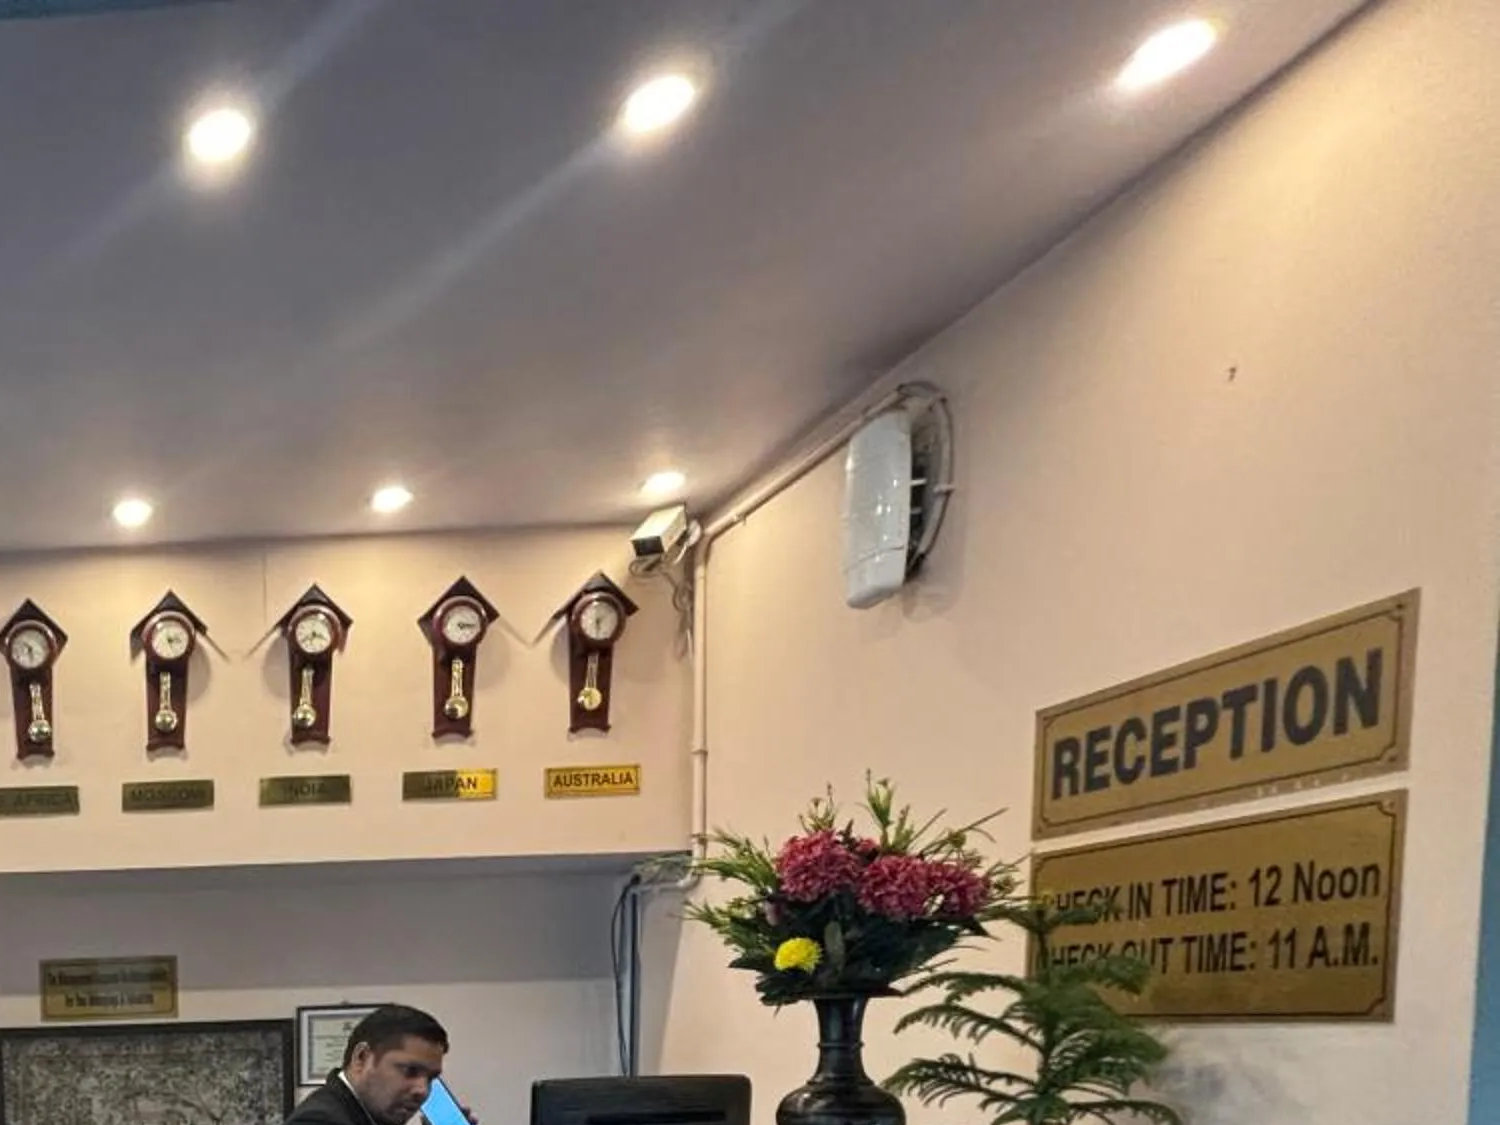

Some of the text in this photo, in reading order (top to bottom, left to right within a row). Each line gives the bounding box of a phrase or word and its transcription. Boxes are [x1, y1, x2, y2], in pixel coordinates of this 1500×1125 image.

[1051, 647, 1383, 800] RECEPTION
[424, 775, 477, 792] JAPAN
[553, 771, 634, 788] AUSTRALIA
[1045, 860, 1381, 922] HECK IN TIME: 12 Noon
[1181, 931, 1257, 975] TIME:
[1267, 926, 1298, 969] 11
[1306, 922, 1379, 969] A.M.
